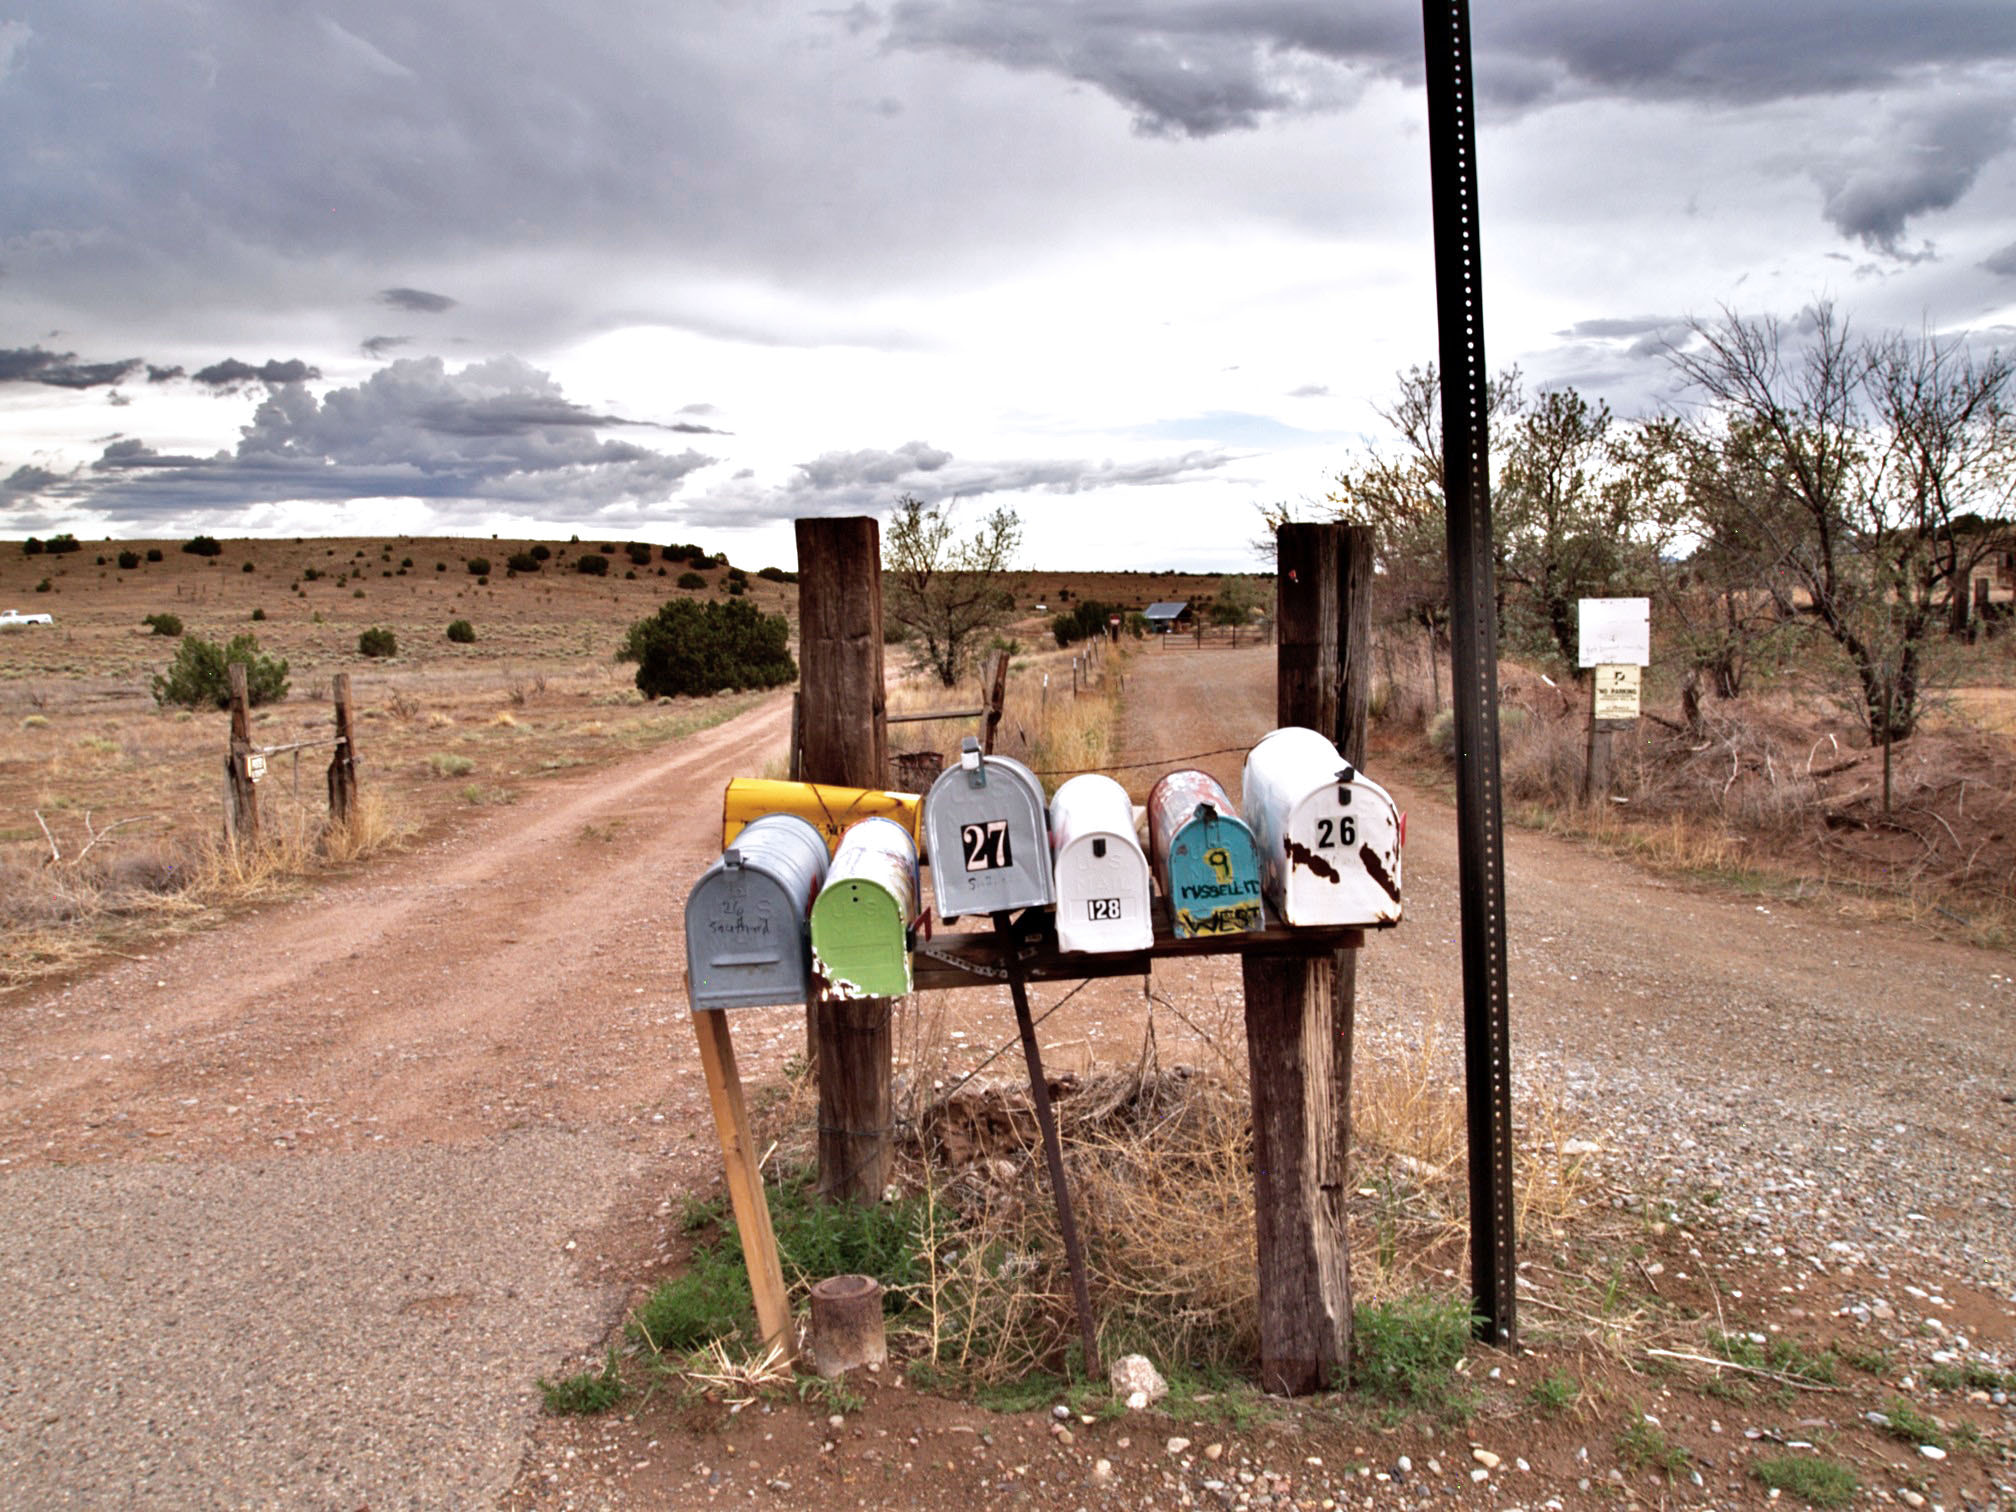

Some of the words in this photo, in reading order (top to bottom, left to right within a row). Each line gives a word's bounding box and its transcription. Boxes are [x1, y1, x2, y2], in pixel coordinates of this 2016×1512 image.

[963, 820, 1008, 871] 27
[1317, 816, 1356, 848] 26
[1208, 851, 1230, 876] 9
[1088, 899, 1121, 920] 128
[1181, 906, 1260, 934] WEST
